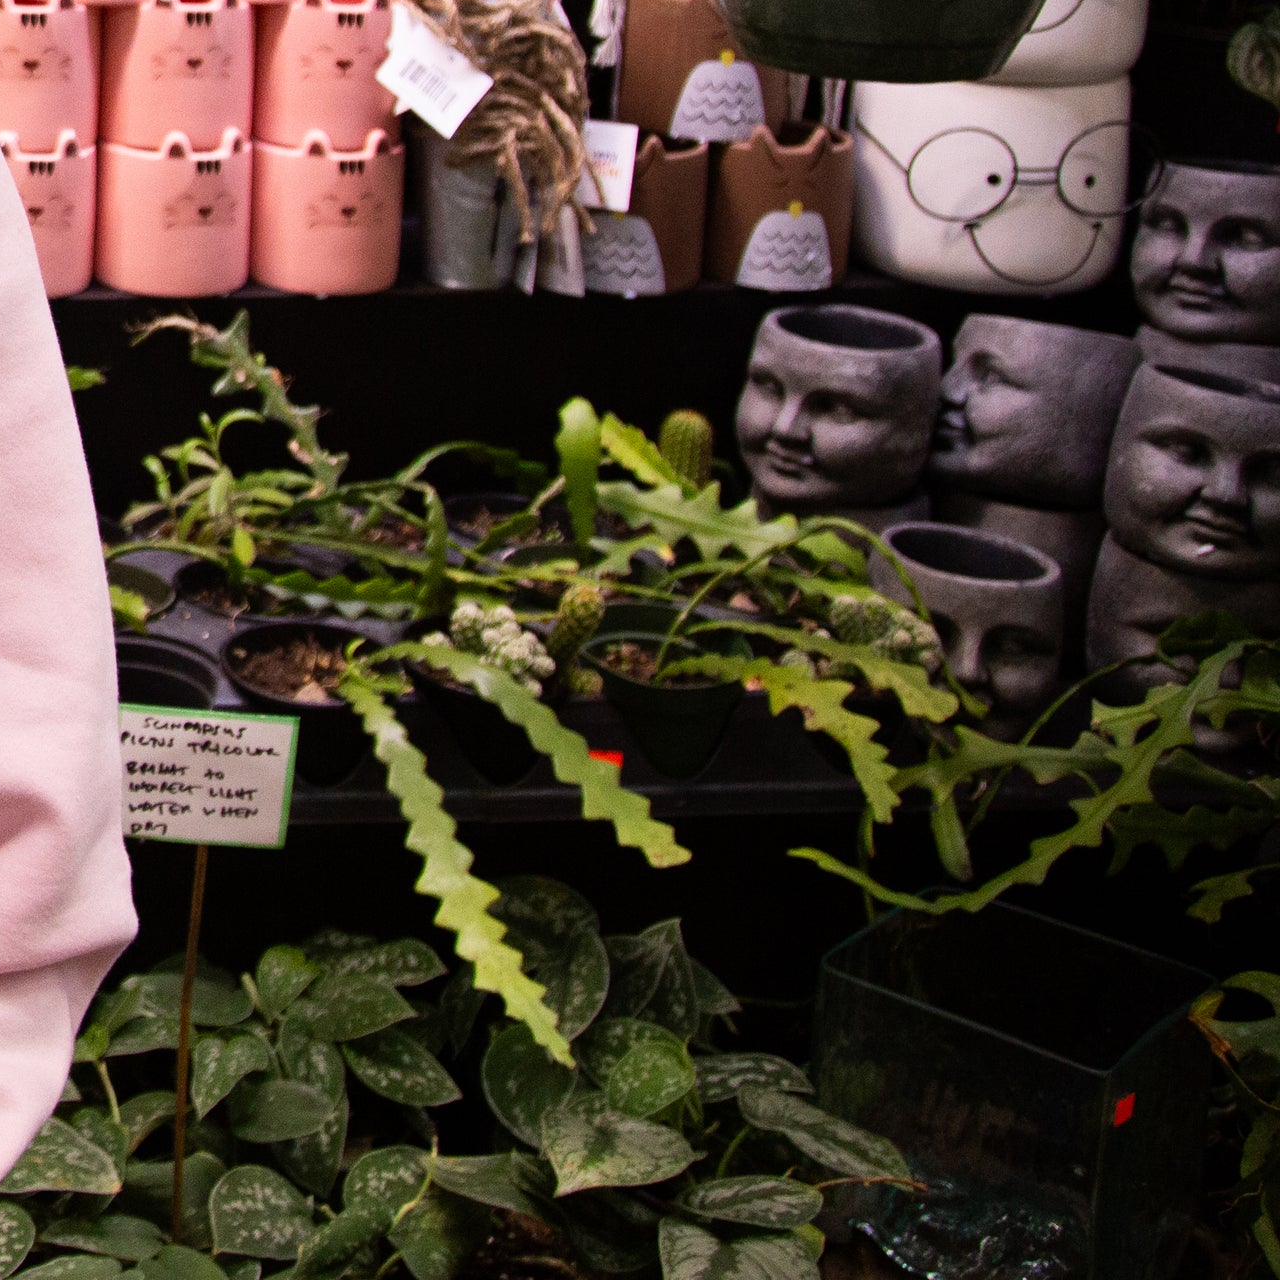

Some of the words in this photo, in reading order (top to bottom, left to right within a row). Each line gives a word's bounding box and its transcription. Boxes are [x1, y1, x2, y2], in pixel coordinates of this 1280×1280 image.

[209, 787, 259, 801] LIGHT
[129, 800, 192, 816] WATER
[202, 805, 259, 819] WHEN
[130, 821, 168, 836] DRY
